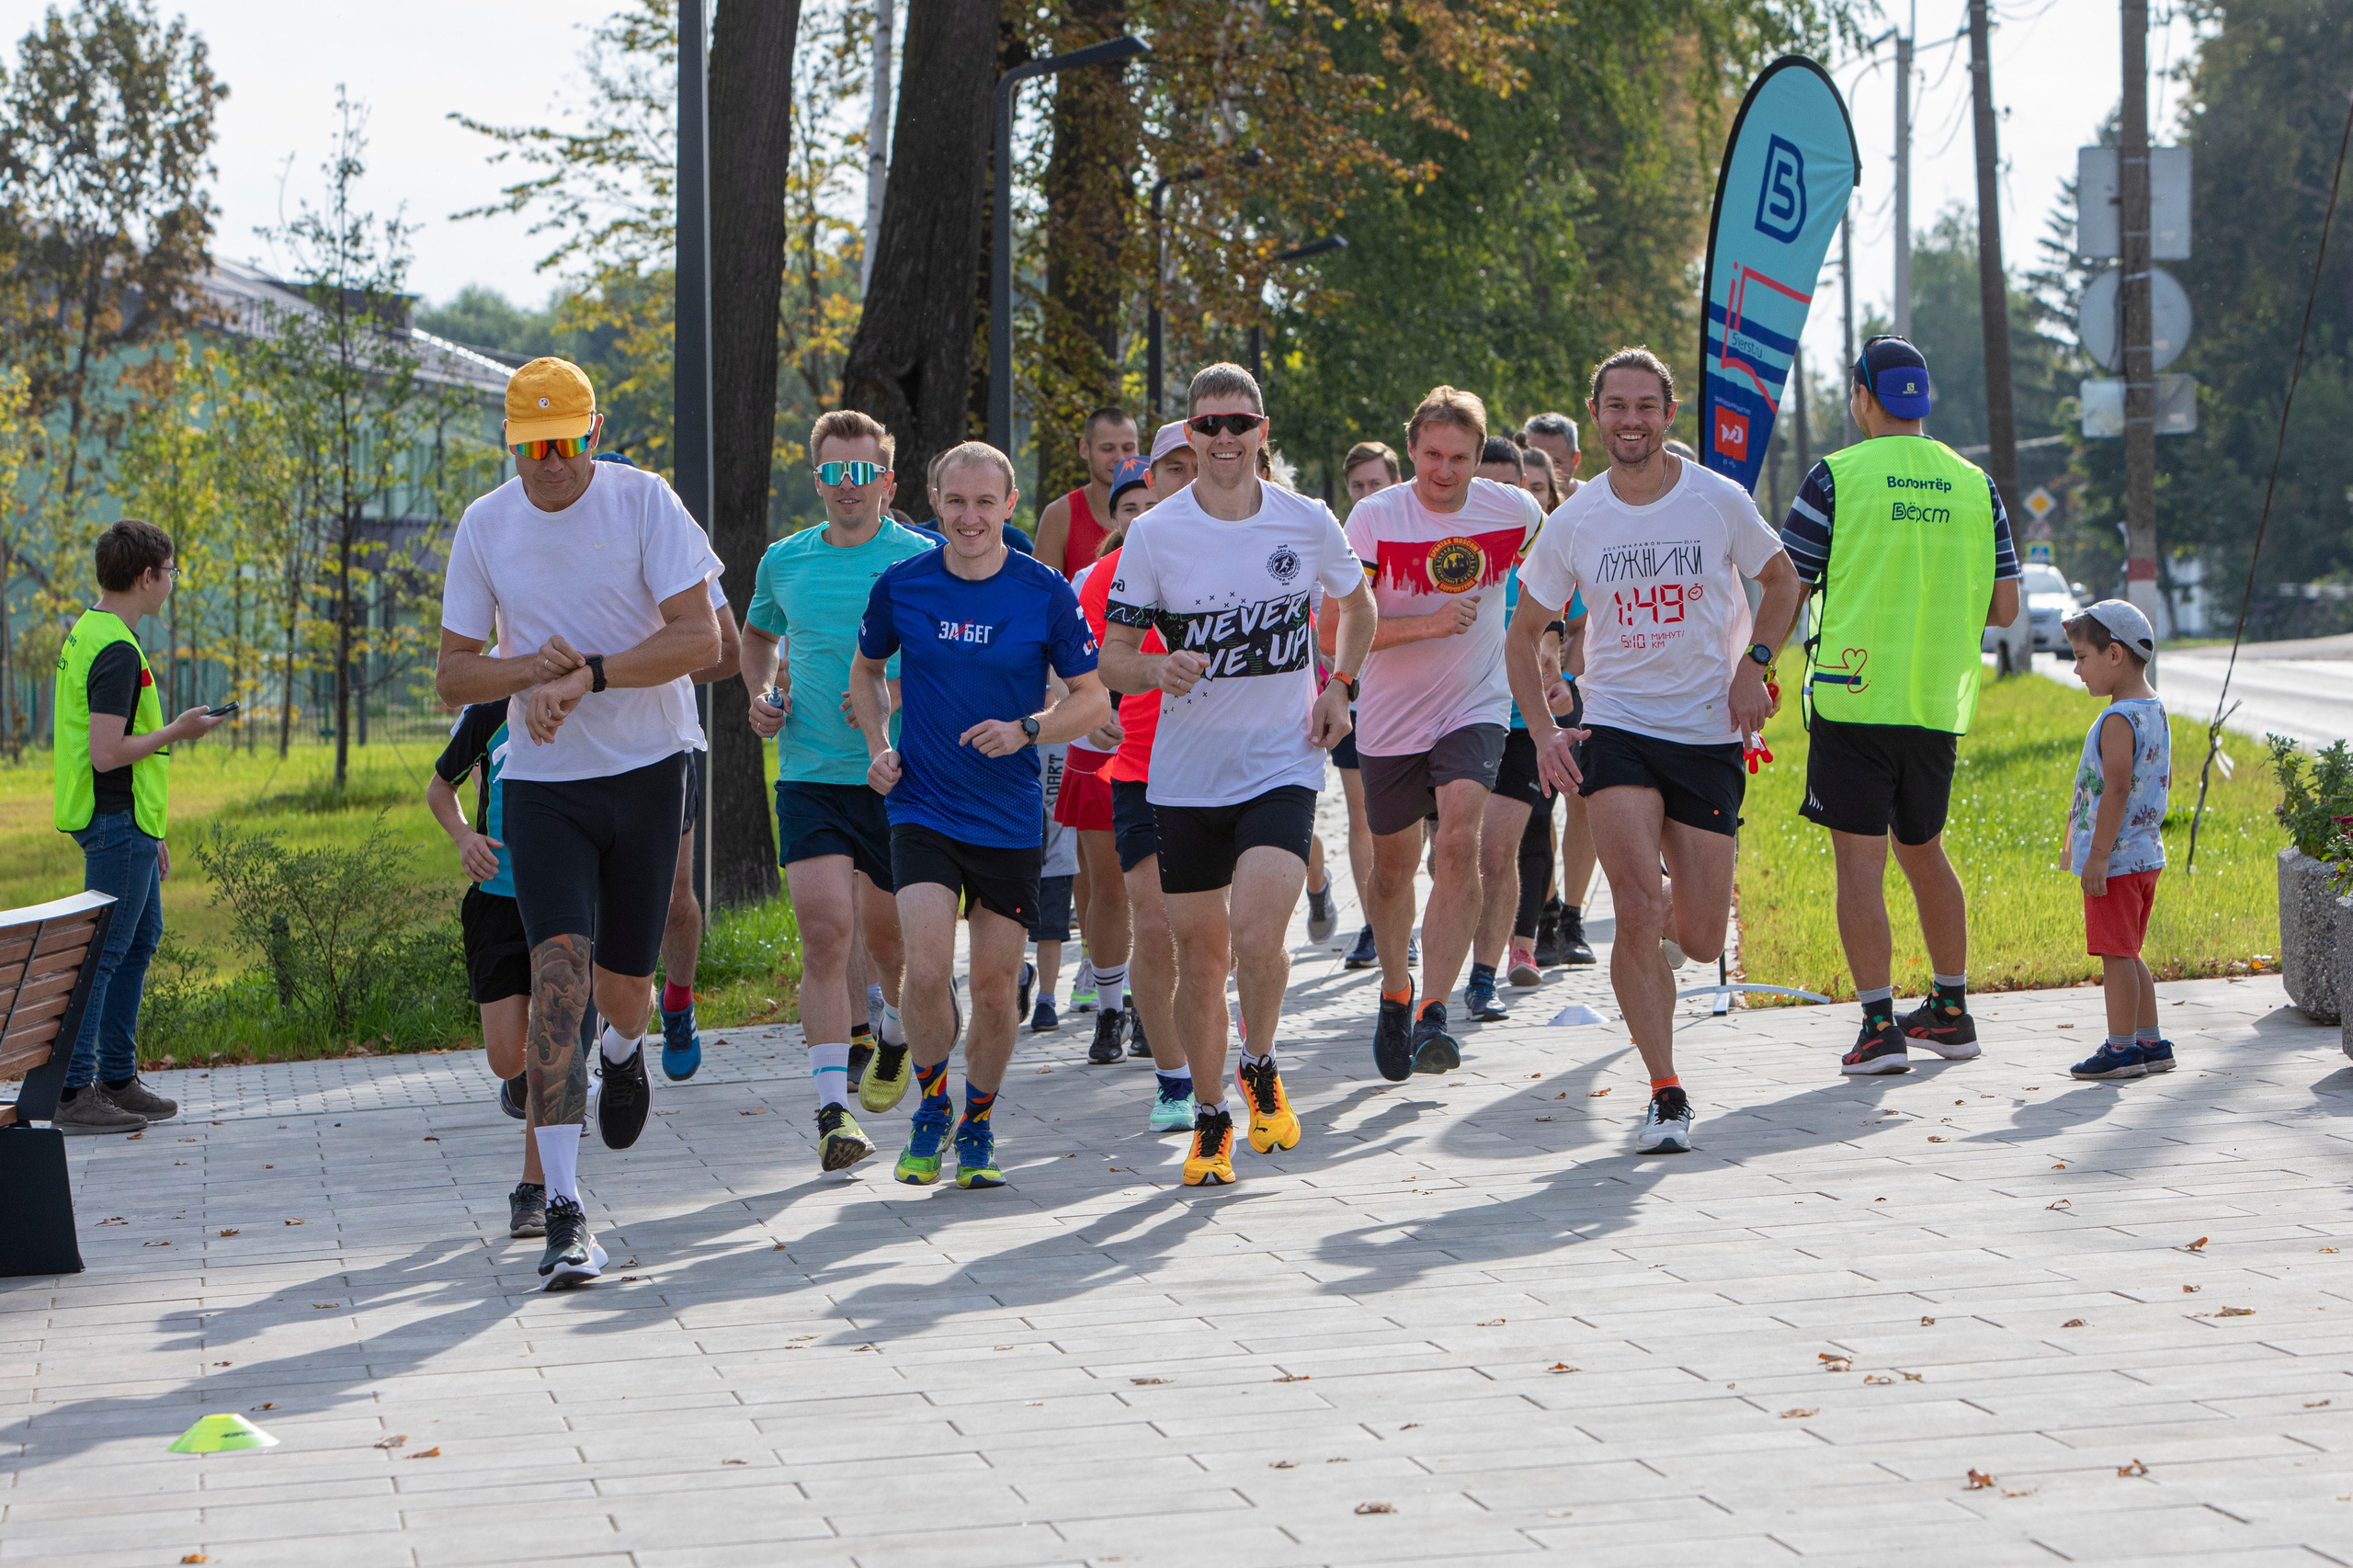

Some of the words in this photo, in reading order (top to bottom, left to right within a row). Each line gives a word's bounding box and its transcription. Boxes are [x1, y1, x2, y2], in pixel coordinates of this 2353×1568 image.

[1887, 475, 1952, 494] Волонтёр
[1269, 549, 1287, 561] GOLDEN
[1431, 538, 1452, 558] SPARTAK
[1453, 538, 1479, 551] MOSCOW
[1603, 540, 1661, 551] ПОЛУМАРАФОН
[1596, 545, 1702, 584] ЛУЖНИКИ
[1270, 573, 1286, 582] ULTRA
[1438, 579, 1475, 592] SUPPORTERS
[1614, 584, 1685, 626] 1:49
[1184, 590, 1307, 649] NEVER
[1268, 622, 1308, 666] UP
[1621, 634, 1646, 649] 5:10
